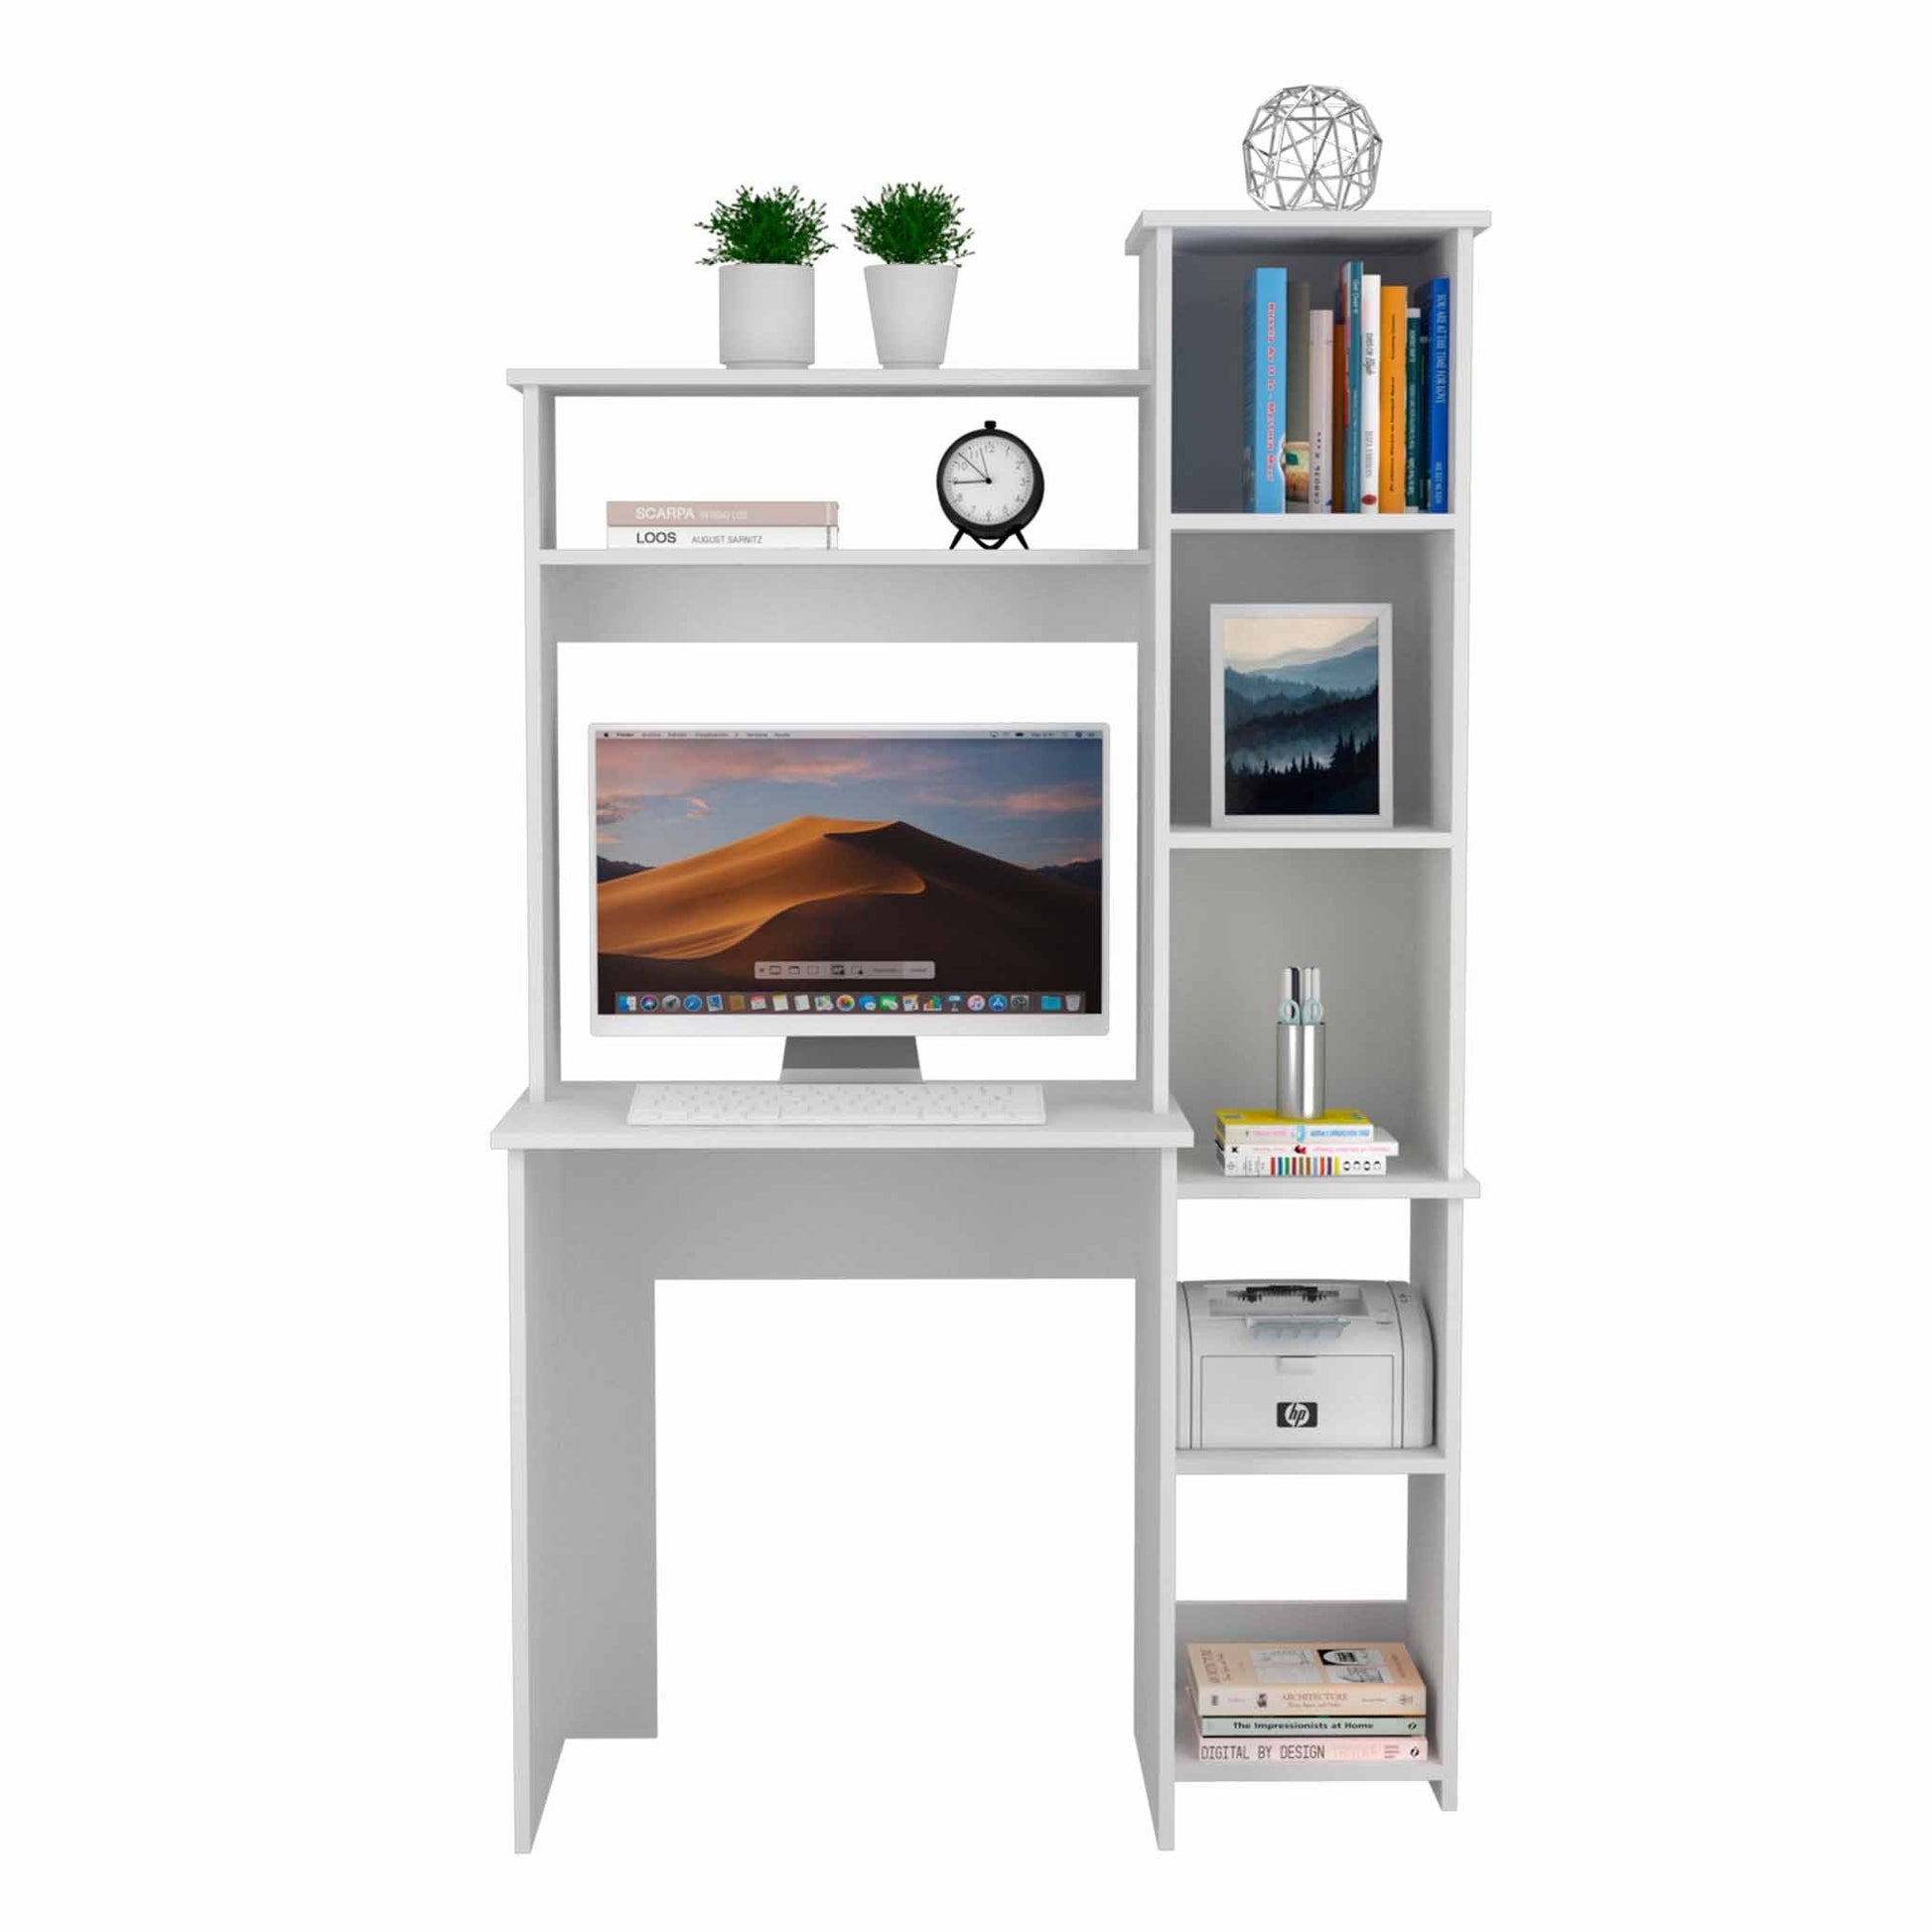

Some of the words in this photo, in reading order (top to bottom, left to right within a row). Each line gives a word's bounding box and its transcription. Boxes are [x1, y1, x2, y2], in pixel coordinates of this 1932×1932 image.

[634, 506, 696, 520] SCARPA
[636, 531, 677, 544] LOOS
[691, 535, 725, 544] AUGUST
[728, 535, 762, 544] SARNITZ
[1254, 1722, 1328, 1730] Impressionists
[1200, 1745, 1250, 1760] DIGITAL
[1258, 1745, 1272, 1759] BY
[1280, 1744, 1325, 1759] DESIGN
